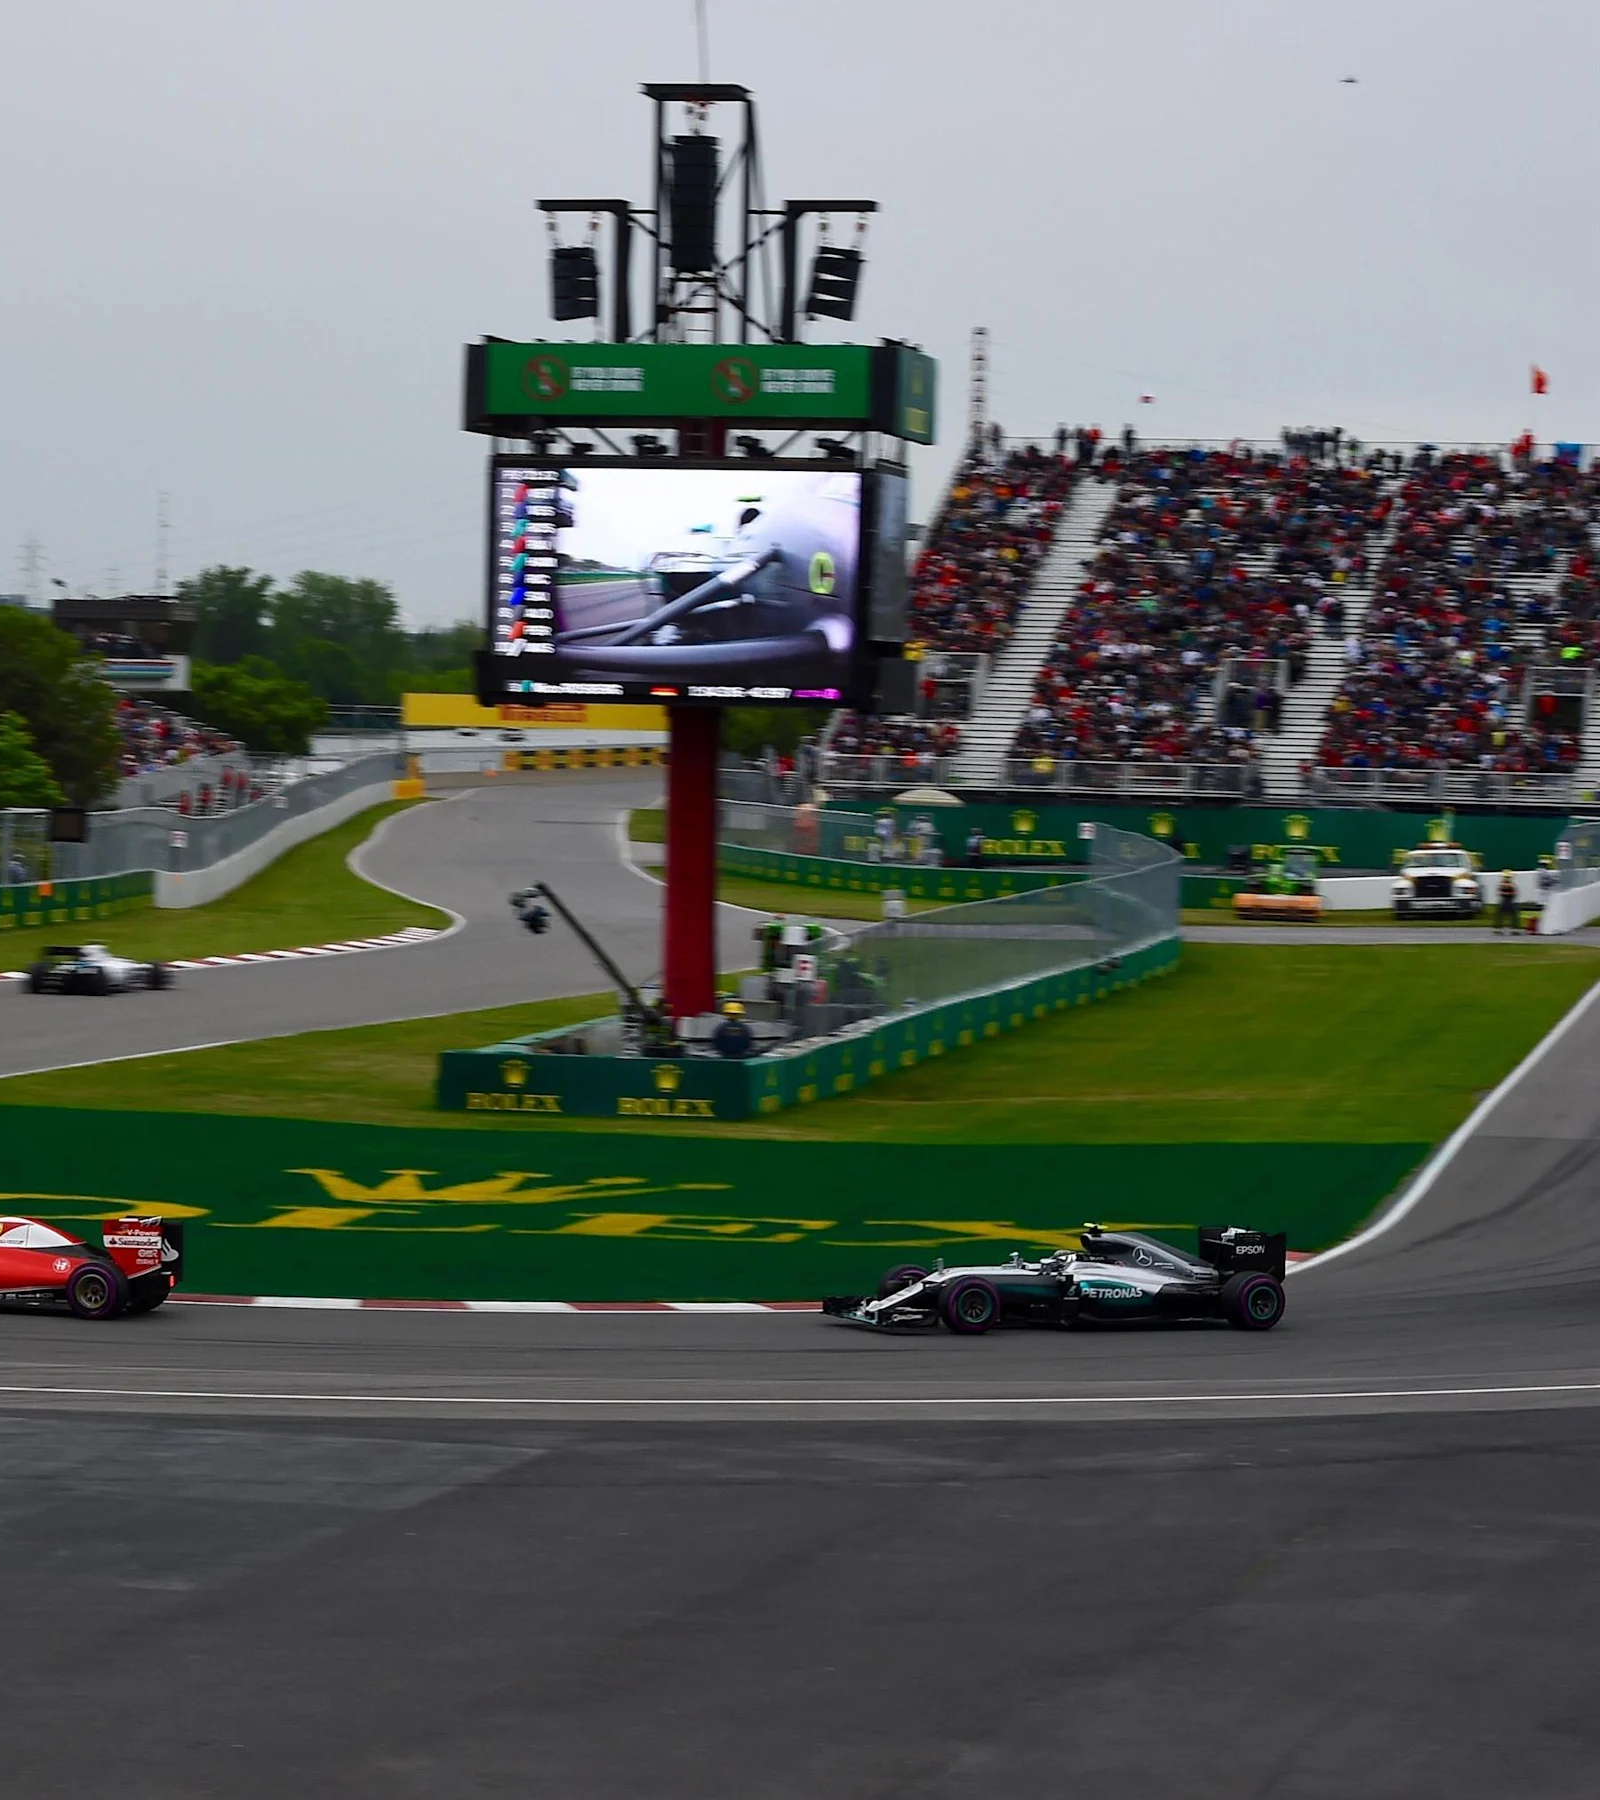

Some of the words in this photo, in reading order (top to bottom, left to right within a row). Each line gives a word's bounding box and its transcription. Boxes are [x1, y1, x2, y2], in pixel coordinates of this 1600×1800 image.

[979, 839, 1067, 857] ROLEX
[465, 1092, 563, 1113] ROLEX
[616, 1097, 716, 1118] ROLEX
[126, 1229, 160, 1237] V-Power
[118, 1237, 158, 1247] Santander
[1236, 1245, 1265, 1255] EPSON
[1067, 1285, 1077, 1297] 6
[1081, 1287, 1144, 1299] PETRONAS
